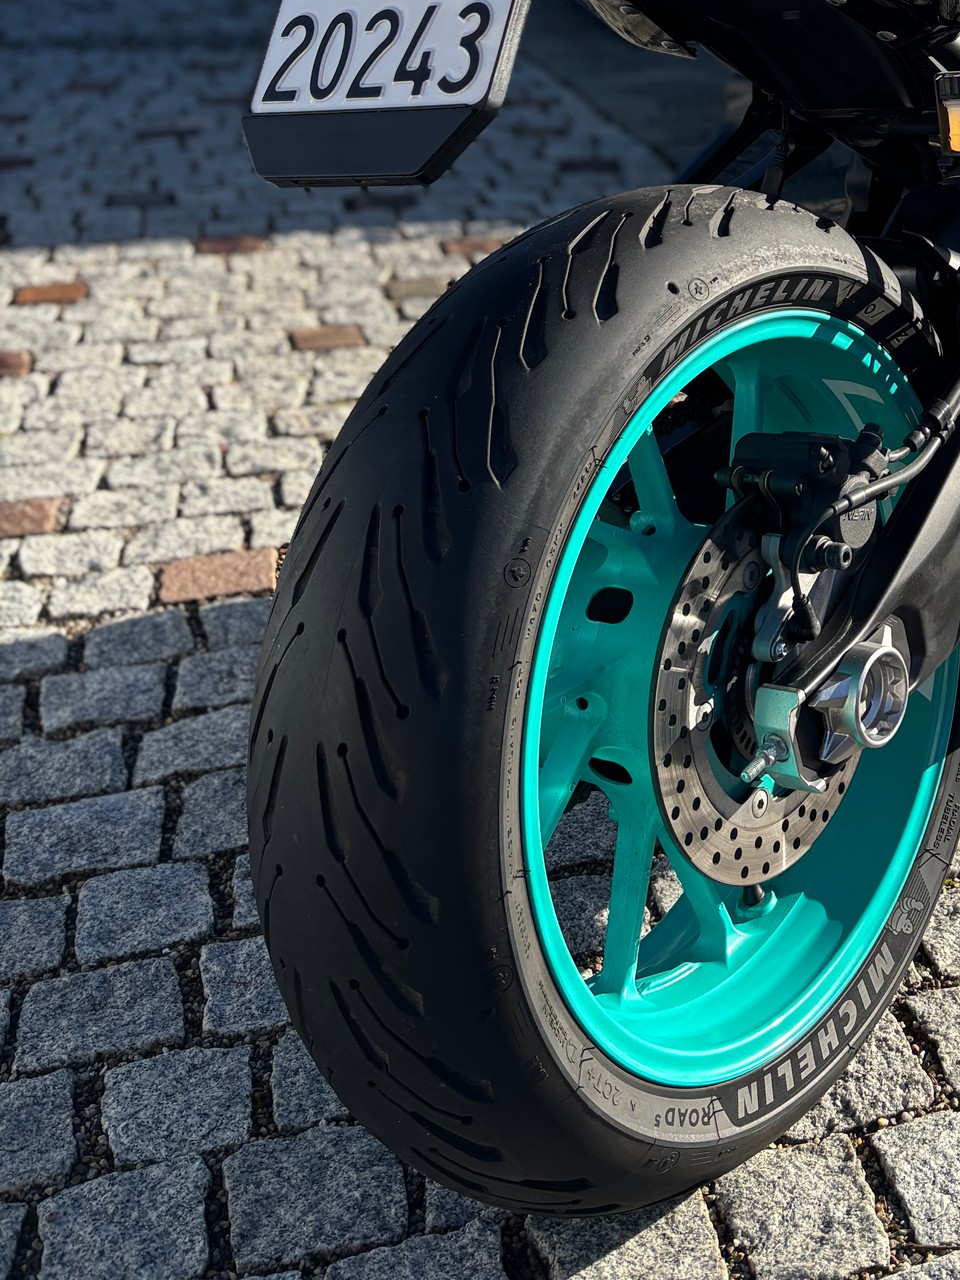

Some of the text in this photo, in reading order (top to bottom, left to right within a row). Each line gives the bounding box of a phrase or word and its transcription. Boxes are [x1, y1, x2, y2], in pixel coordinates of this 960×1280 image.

[261, 1, 491, 102] 20243
[659, 276, 837, 373] MICHELIN
[933, 792, 956, 849] TUBELESS
[943, 802, 960, 843] RADIAL
[737, 942, 895, 1120] MICHELIN
[664, 1106, 711, 1128] ROAD
